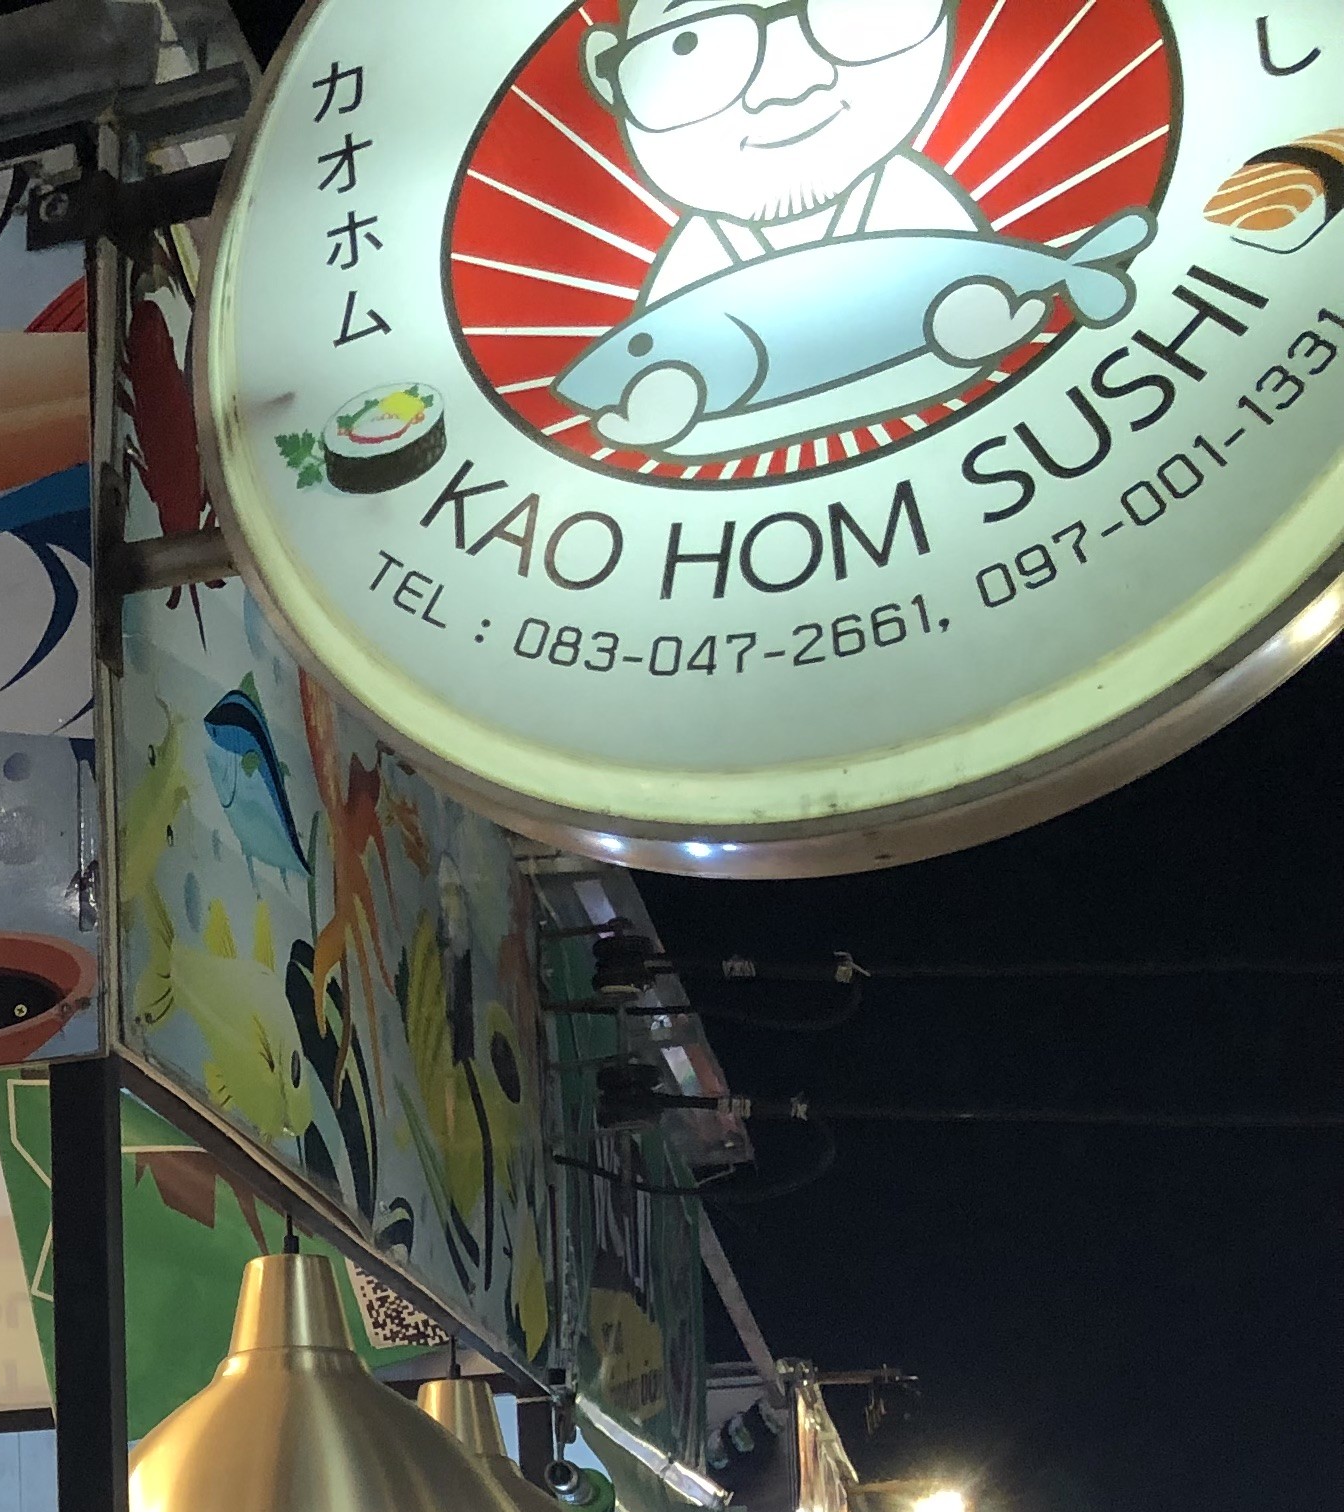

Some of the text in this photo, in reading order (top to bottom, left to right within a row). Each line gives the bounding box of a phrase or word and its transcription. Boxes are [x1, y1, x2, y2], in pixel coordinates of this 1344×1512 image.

[312, 60, 393, 351] カオホム
[419, 265, 1270, 600] KAO HOM SUSHI
[367, 549, 450, 633] TEL
[515, 594, 952, 677] 083-047-2661,
